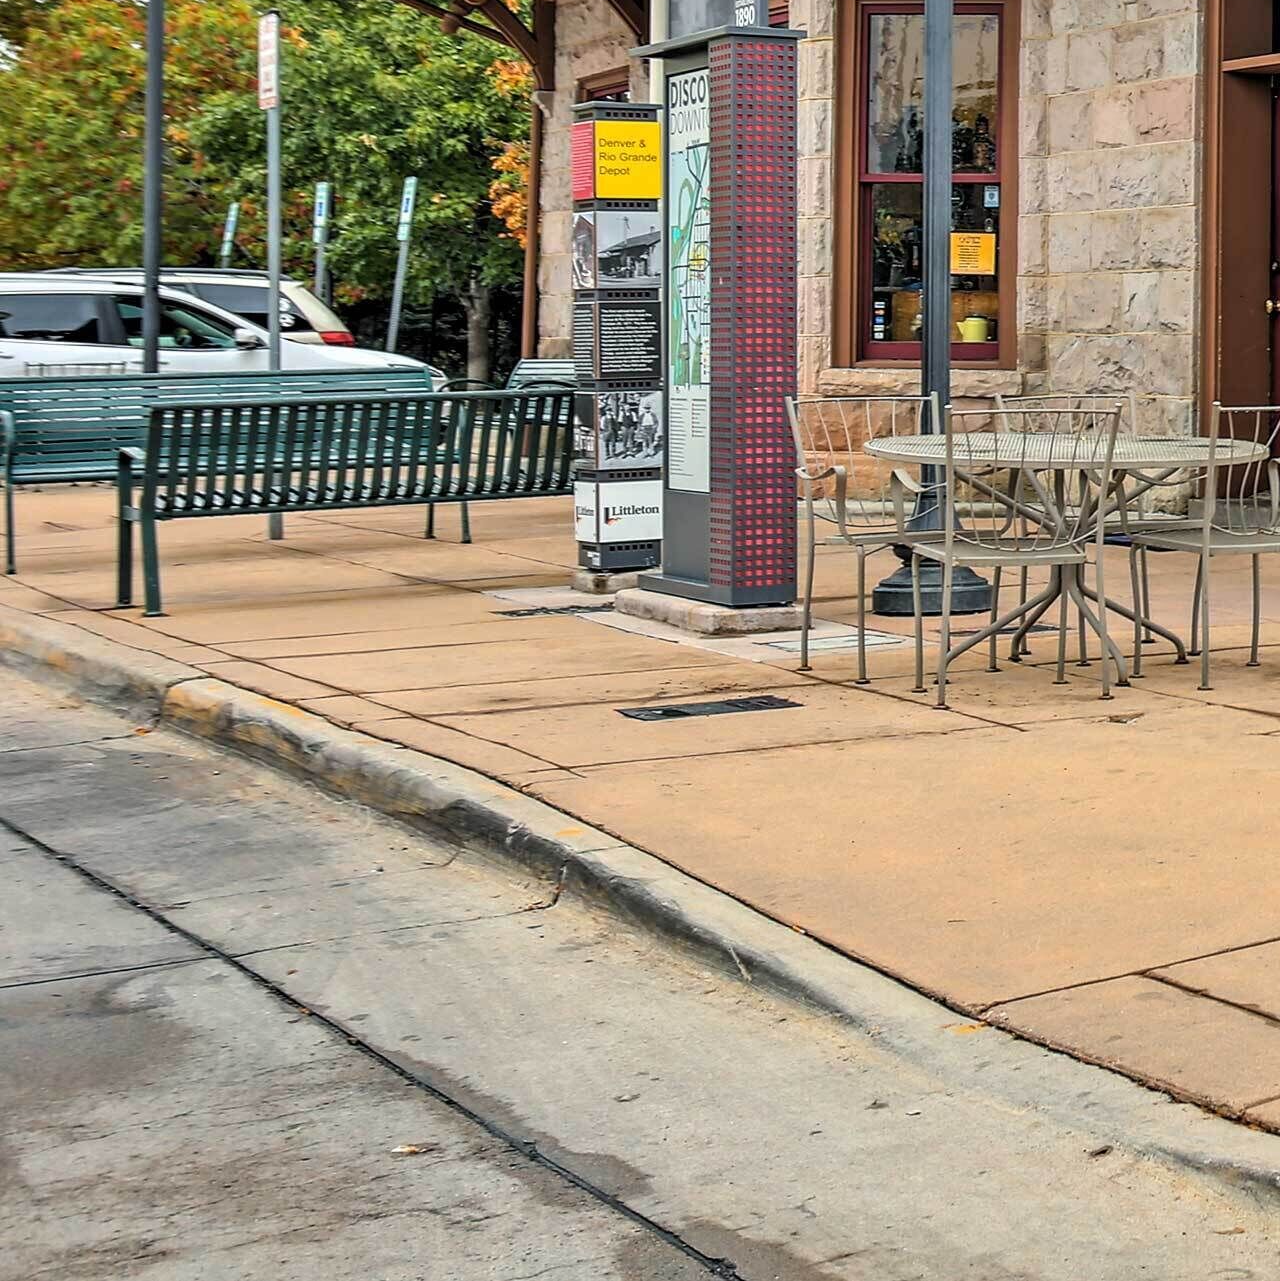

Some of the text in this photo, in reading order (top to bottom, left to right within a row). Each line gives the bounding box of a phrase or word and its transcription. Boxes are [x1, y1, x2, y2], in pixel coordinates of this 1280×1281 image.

[735, 5, 755, 27] 1890
[670, 75, 710, 109] DISCO
[599, 138, 646, 148] Denver &
[599, 152, 657, 162] Rio Grande
[599, 166, 630, 176] Depot
[612, 505, 660, 516] Littleton
